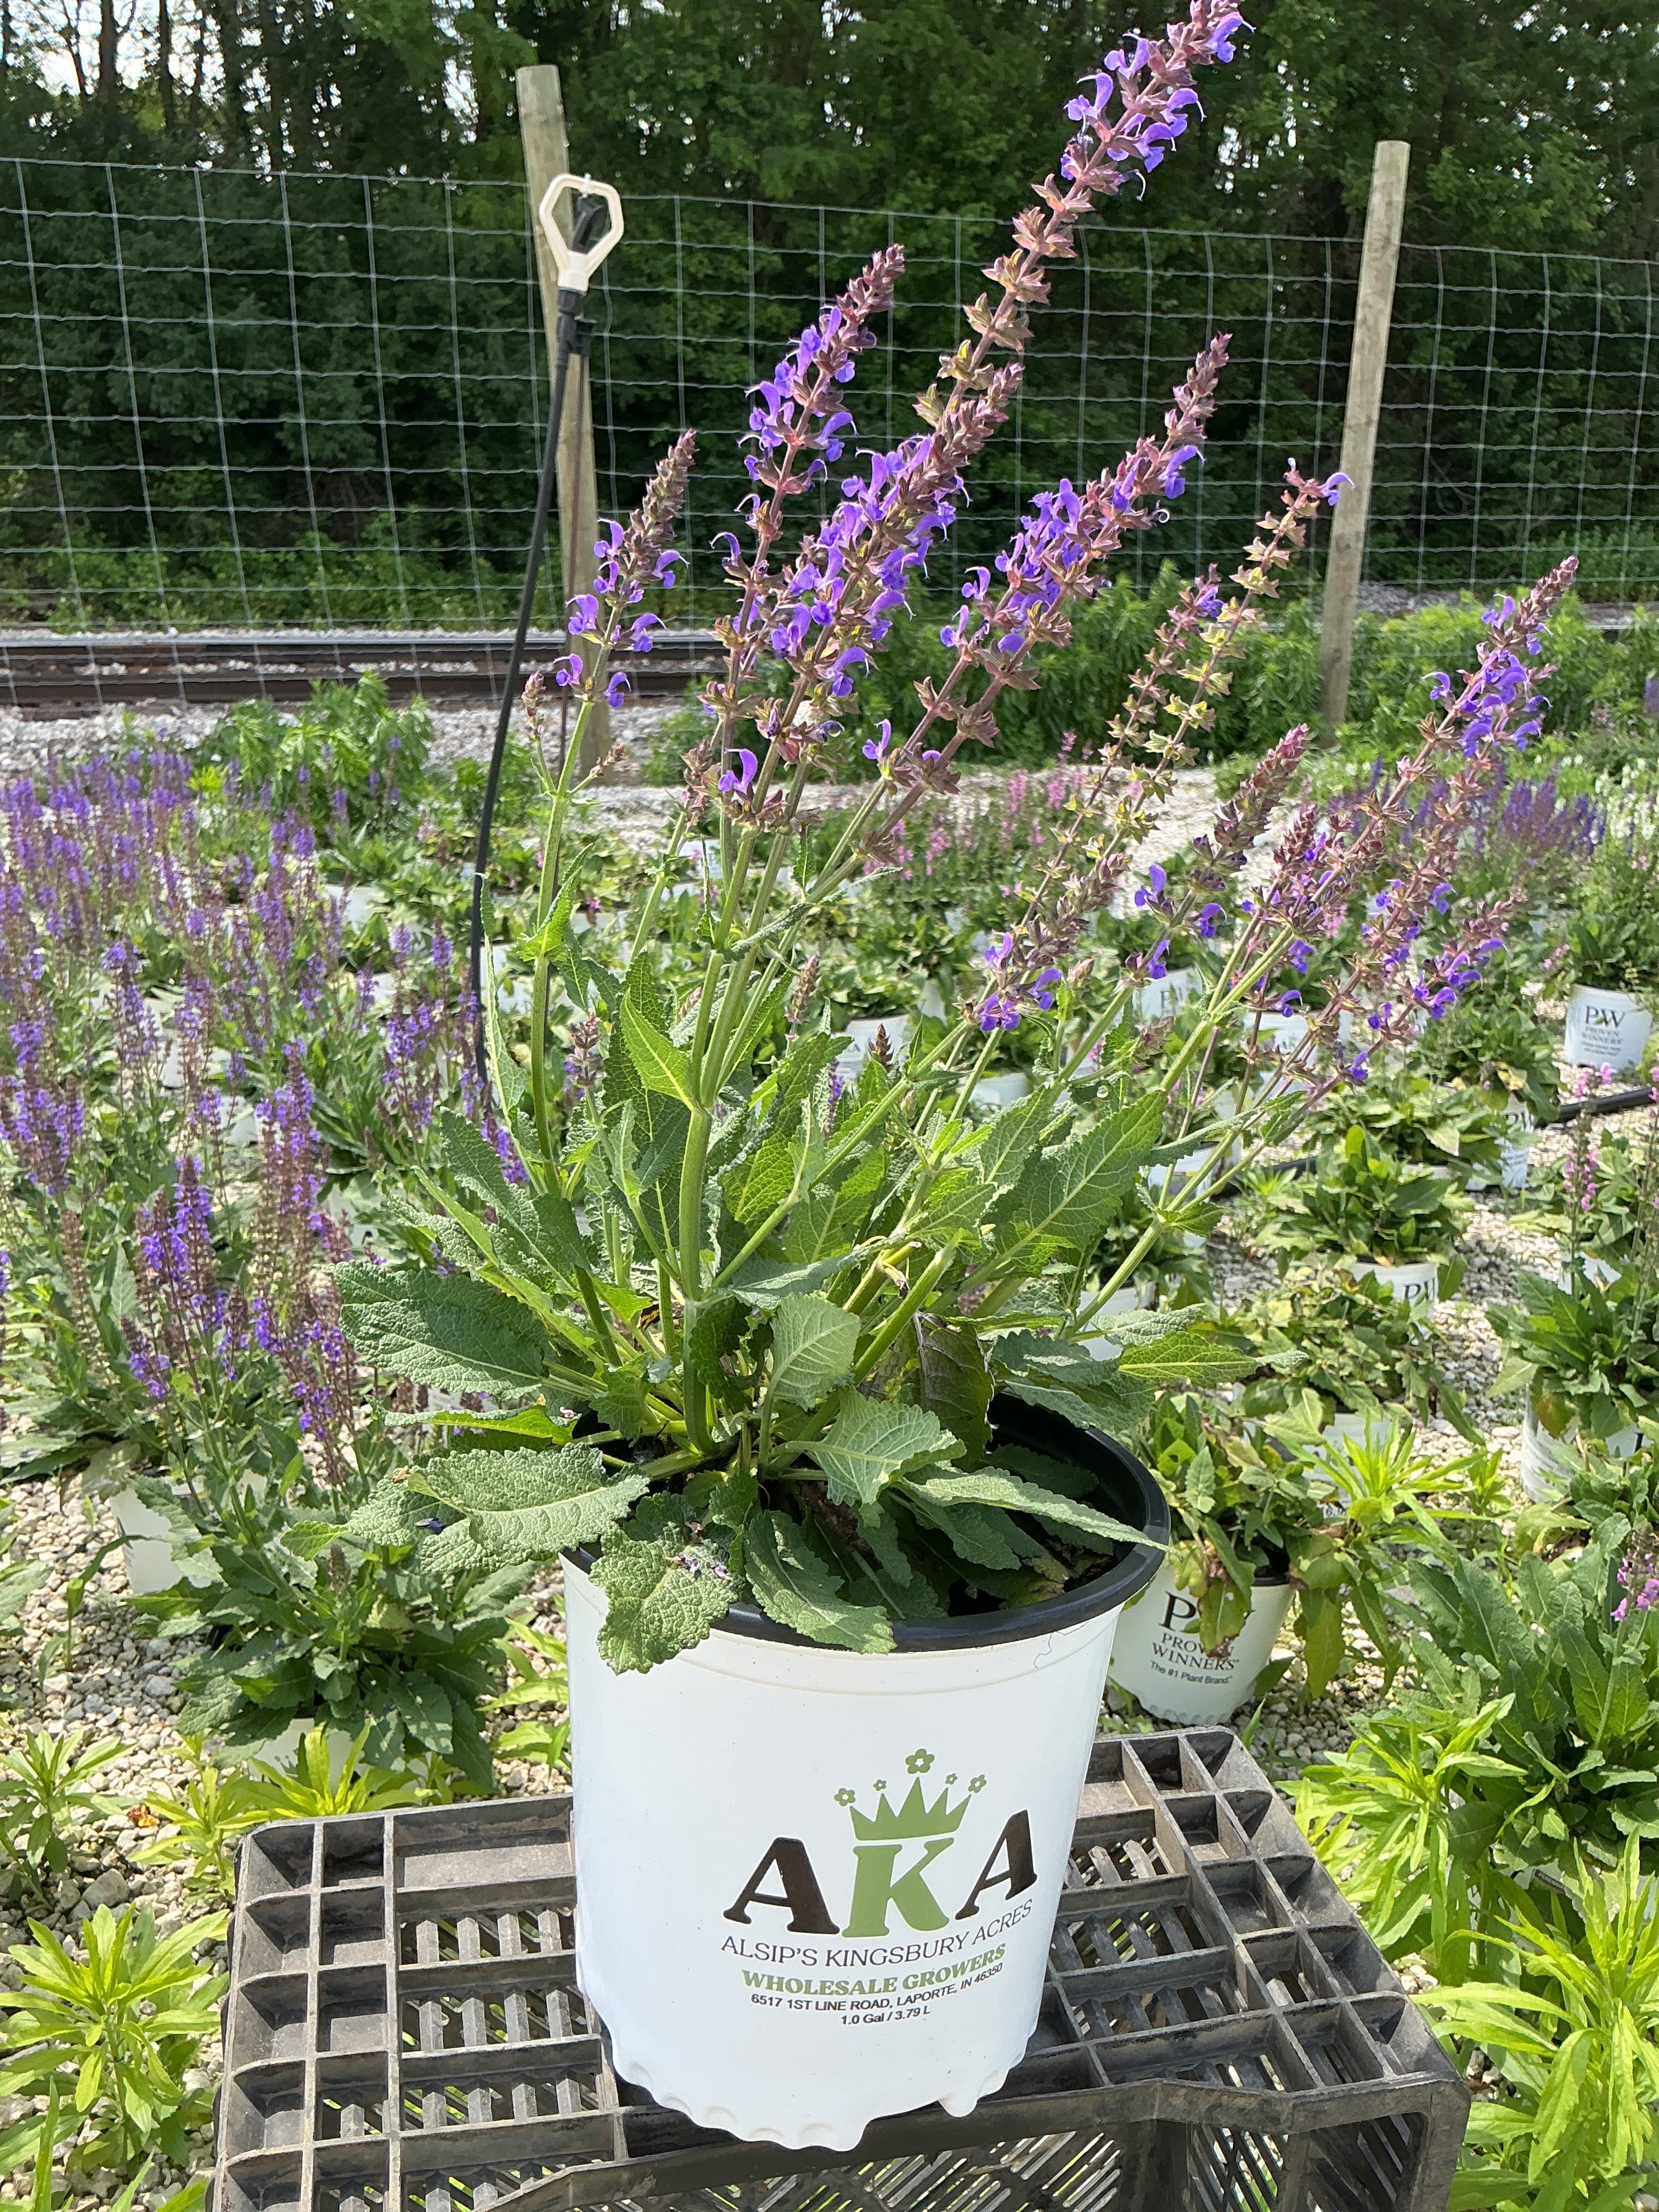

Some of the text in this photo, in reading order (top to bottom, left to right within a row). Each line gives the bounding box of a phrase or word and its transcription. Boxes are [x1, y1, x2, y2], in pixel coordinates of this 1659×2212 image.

[1585, 1005, 1626, 1028] PW
[1158, 1590, 1197, 1632] P
[1150, 1660, 1166, 1674] The
[1167, 1668, 1178, 1678] #1
[1181, 1672, 1204, 1683] Plant
[723, 1809, 1037, 1938] AKA
[720, 1898, 1032, 1967] ALSIP’S KINGSBURY ACRES
[741, 1943, 1006, 1996] WHOLESALE GROWERS
[751, 1993, 783, 2007] 6517
[786, 1999, 813, 2011] 1ST
[815, 2001, 847, 2011] LINE
[896, 1983, 957, 2006] LAPORTE,
[960, 1977, 973, 1990] IN
[973, 1962, 1003, 1984] 46350
[841, 2005, 932, 2025] 1.0 Gal / 3.79 L
